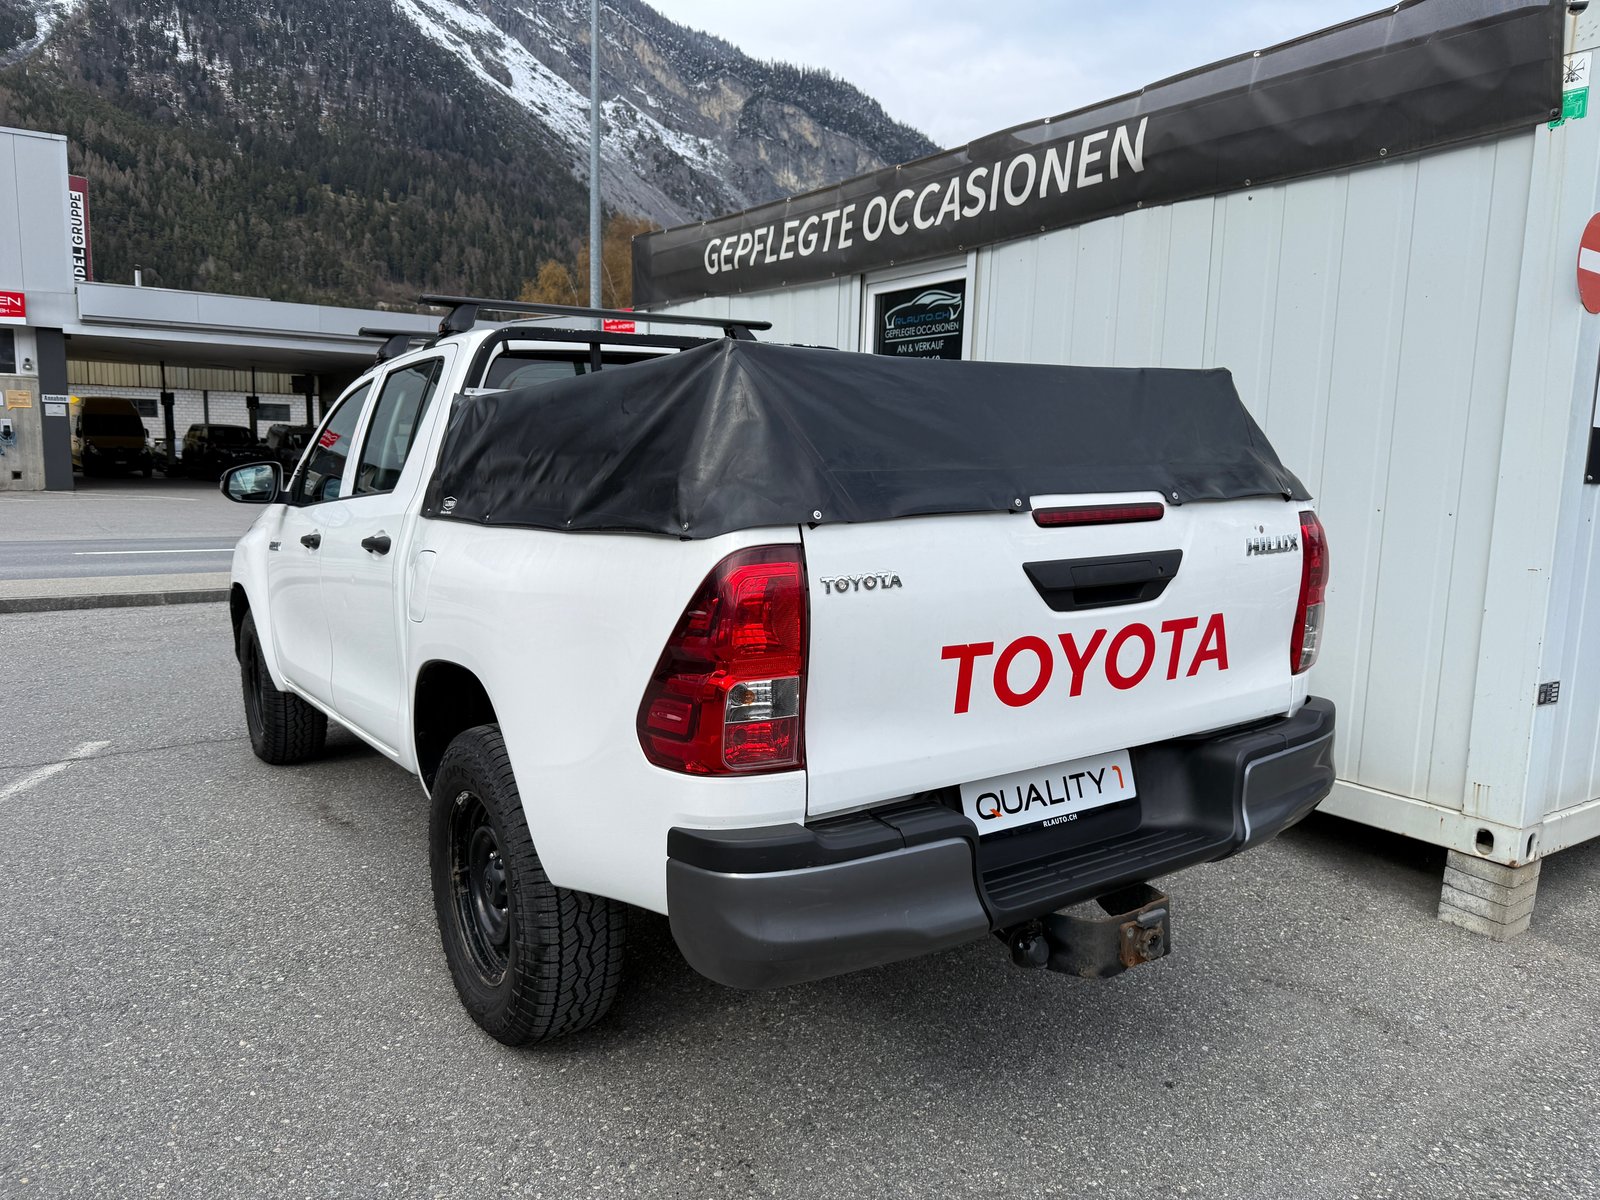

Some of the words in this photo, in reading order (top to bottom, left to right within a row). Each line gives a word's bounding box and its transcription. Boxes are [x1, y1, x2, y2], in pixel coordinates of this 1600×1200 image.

[703, 204, 855, 275] GEPFLEGTE
[862, 117, 1148, 242] OCCASIONEN
[895, 311, 950, 325] RLAUTO.CH
[885, 326, 915, 338] GEPFLEGTE
[916, 322, 959, 334] OCCASIONEN
[897, 344, 908, 353] AN
[908, 343, 913, 352] &
[914, 340, 944, 351] VERKAUF
[1246, 534, 1298, 556] HILUX
[820, 571, 902, 594] TOYOTA
[941, 613, 1229, 714] TOYOTA
[976, 768, 1105, 820] QUALITY
[1112, 765, 1124, 789] 1
[1043, 814, 1078, 828] RLAUTO.CH
